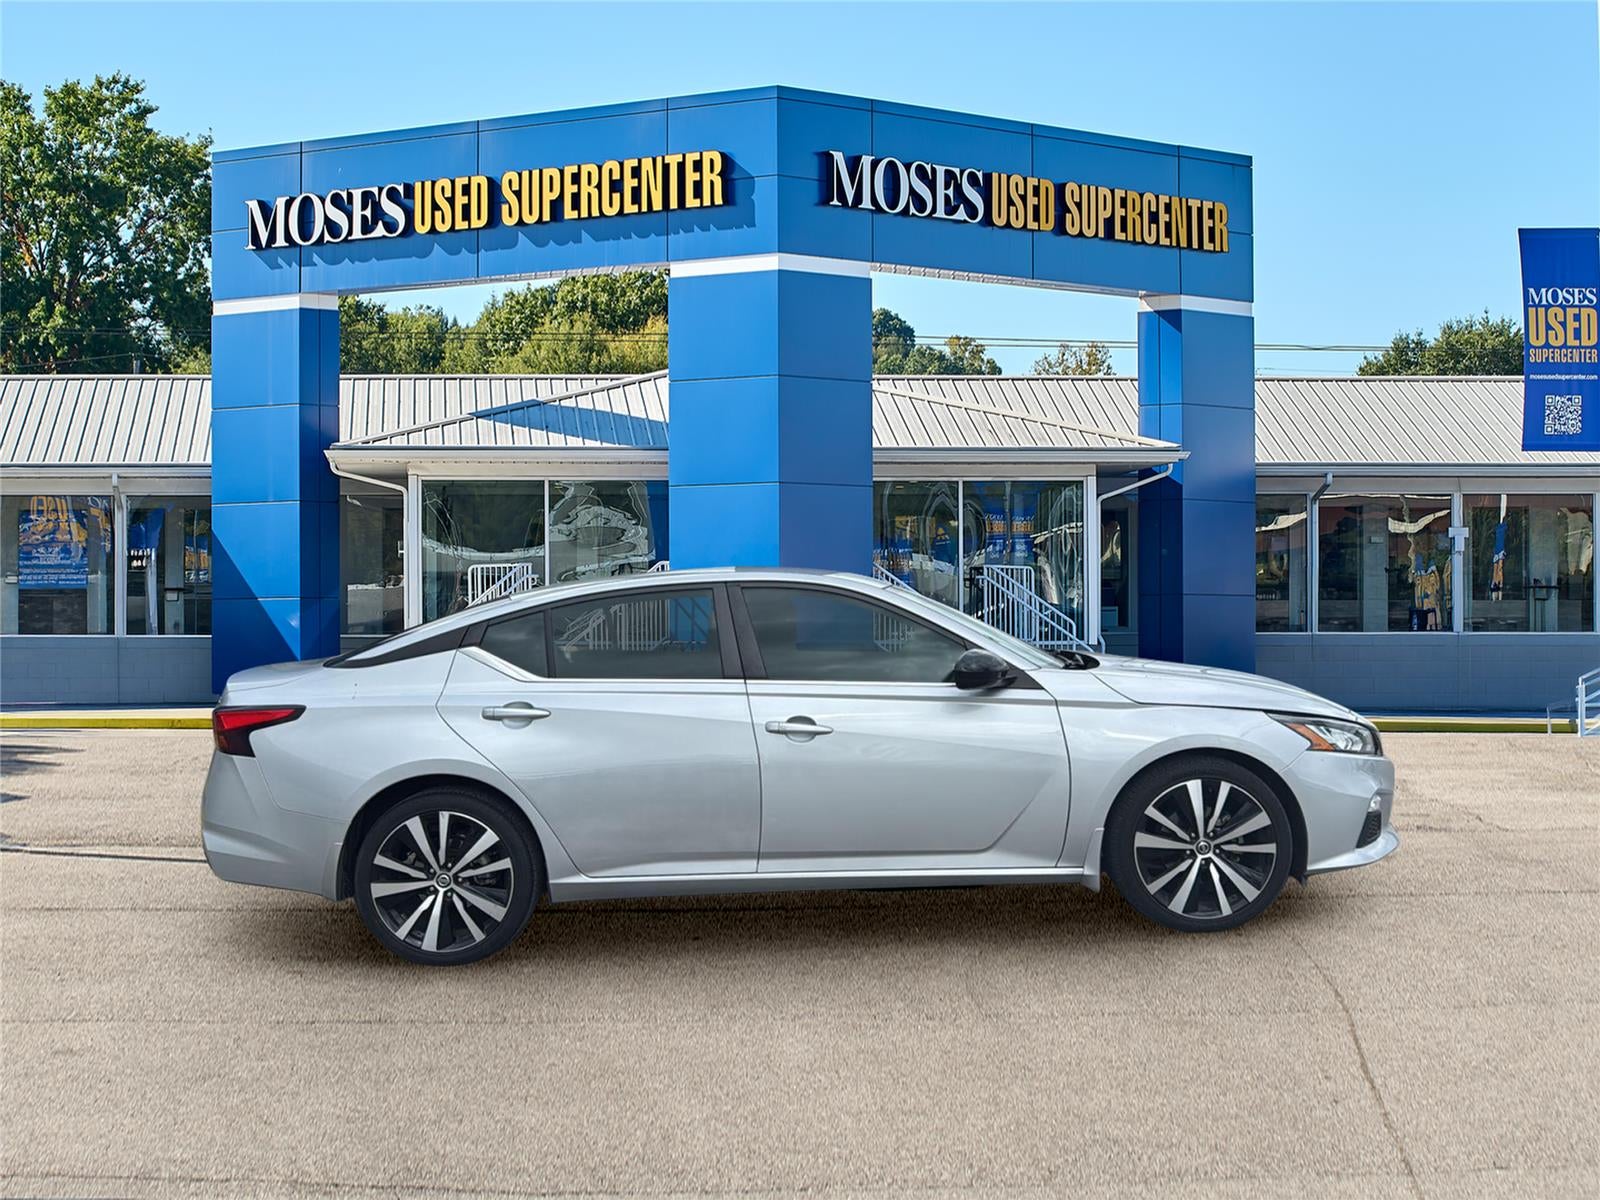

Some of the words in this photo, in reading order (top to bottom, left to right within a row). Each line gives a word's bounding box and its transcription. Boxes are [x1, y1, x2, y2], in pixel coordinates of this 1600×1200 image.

[245, 184, 407, 250] MOSES
[414, 176, 488, 234] USED
[501, 150, 724, 226] SUPERCENTER
[829, 150, 984, 223] MOSES
[991, 172, 1055, 231] USED
[1065, 182, 1229, 252] SUPERCENTER
[1528, 287, 1597, 305] MOSES
[1528, 307, 1598, 346] USED
[1529, 348, 1598, 363] SUPERCENTER
